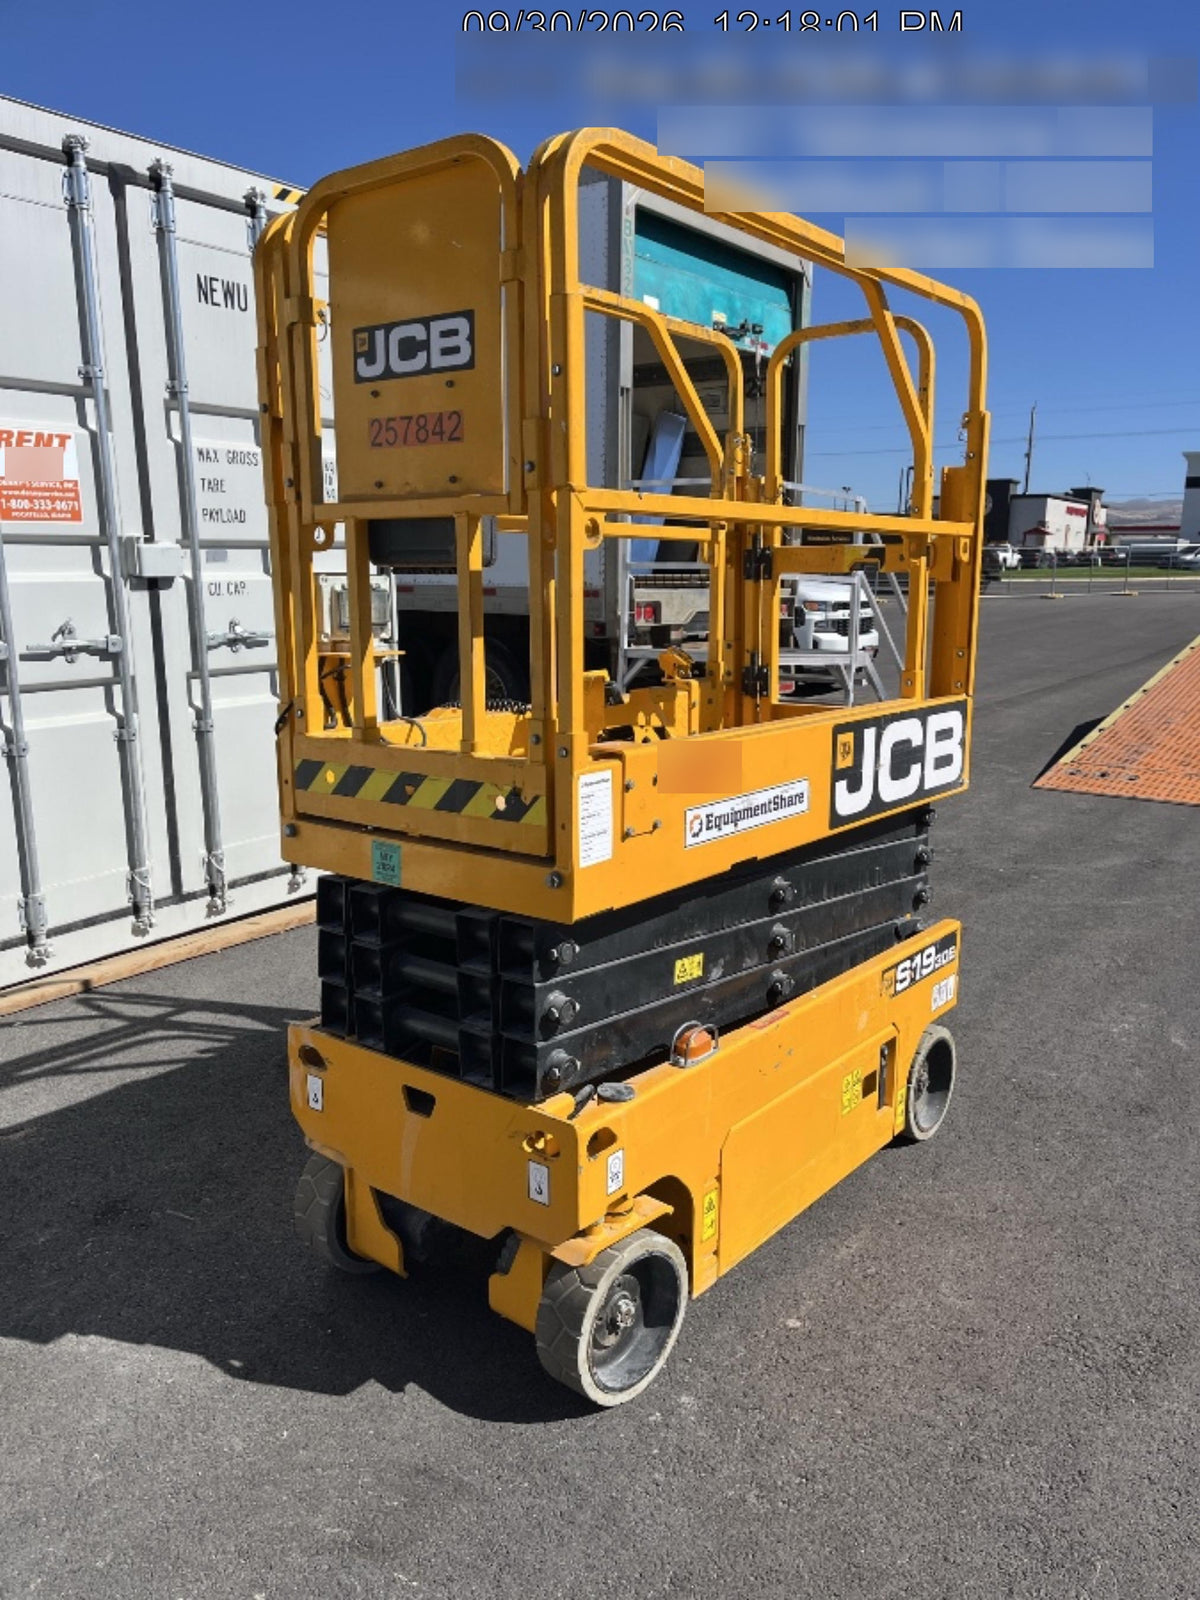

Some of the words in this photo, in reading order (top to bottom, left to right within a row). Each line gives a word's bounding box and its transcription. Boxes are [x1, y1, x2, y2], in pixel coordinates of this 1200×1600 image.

[196, 273, 248, 312] NEWU
[356, 316, 472, 378] JCB
[0, 429, 72, 452] RENT
[370, 410, 462, 447] 257842
[197, 447, 219, 463] MAX
[226, 449, 259, 466] GROSS
[200, 477, 226, 493] TARE
[202, 507, 246, 523] PAYLOAD
[835, 710, 963, 816] JCB
[705, 792, 804, 831] EquipmentShare
